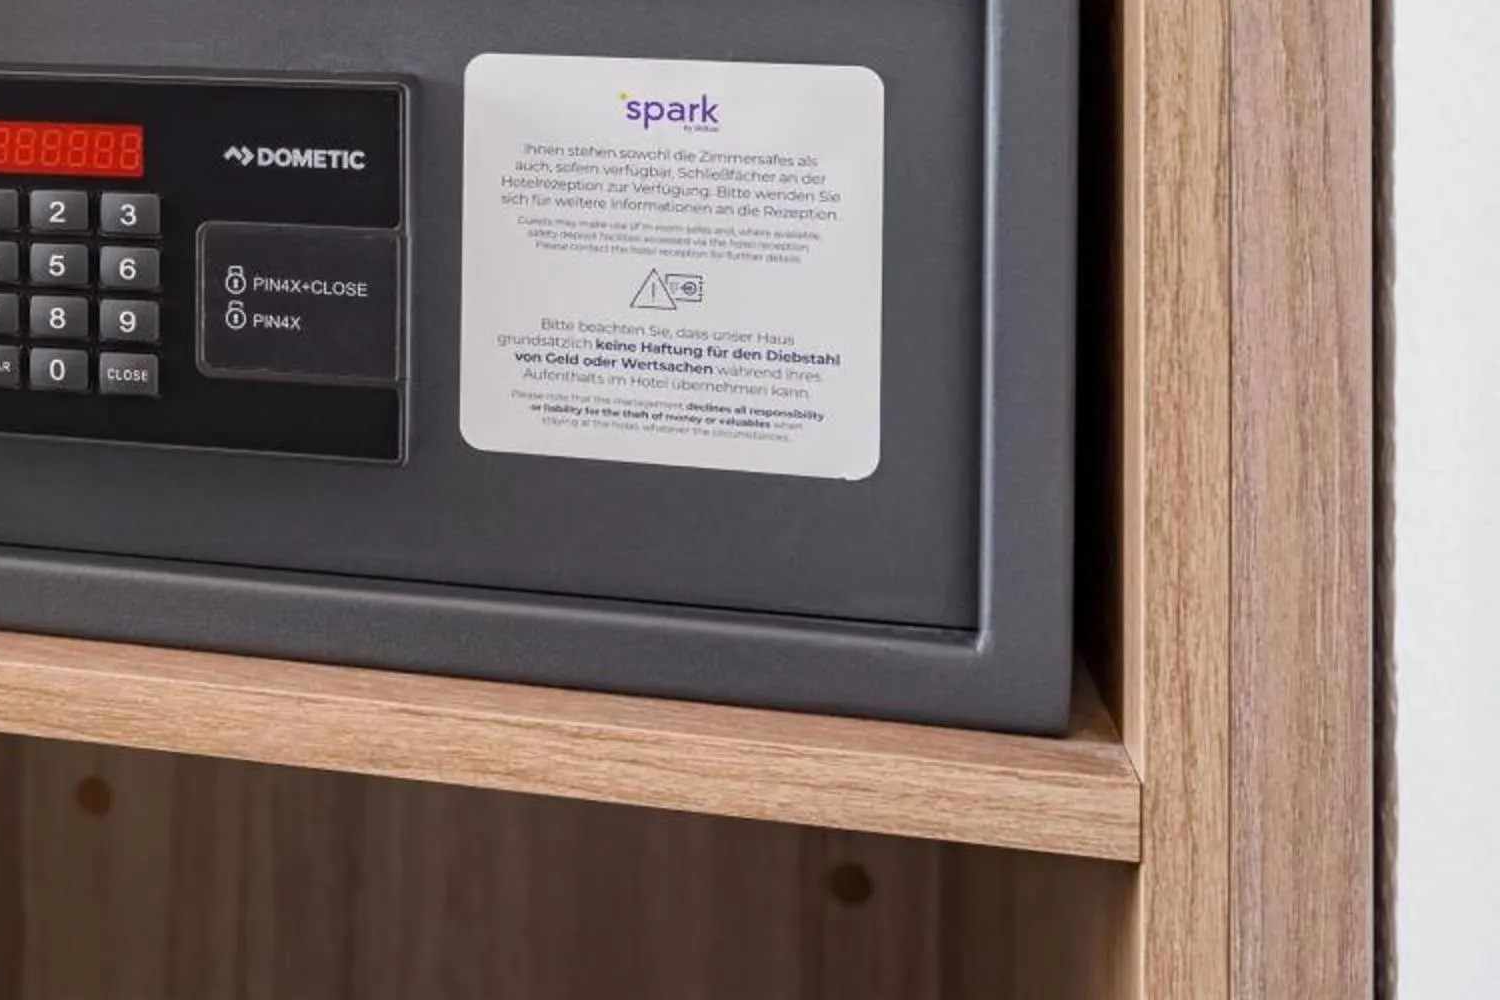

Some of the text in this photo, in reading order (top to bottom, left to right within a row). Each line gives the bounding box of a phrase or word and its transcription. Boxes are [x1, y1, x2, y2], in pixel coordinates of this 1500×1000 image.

[626, 94, 719, 129] spark
[257, 146, 366, 171] DOMETIC
[523, 143, 818, 167] Ihnen stehen sowohl die Zimmersafes als
[555, 161, 599, 174] sofern
[779, 174, 798, 183] an
[801, 173, 826, 185] der
[501, 176, 602, 193] Hotelrezeption
[606, 184, 629, 193] zur
[716, 186, 751, 199] Bitte
[755, 188, 814, 202] wenden
[818, 191, 841, 203] Sie
[49, 201, 66, 223] 2
[119, 203, 137, 226] 3
[501, 193, 529, 205] sich
[555, 196, 606, 209] weitere
[610, 198, 712, 214] Informationen
[715, 206, 734, 215] an
[738, 205, 760, 217] die
[49, 254, 65, 277] 5
[119, 258, 136, 280] 6
[252, 276, 368, 296] PIN4X+CLOSE
[49, 307, 66, 329] 8
[119, 311, 136, 333] 9
[252, 313, 301, 331] PIN4X
[541, 318, 795, 346] Bitte beachten Sie, dass unser Haus
[515, 352, 541, 363] von
[545, 351, 579, 365] Geld
[583, 354, 617, 368] oder
[621, 357, 713, 375] Wertsachen
[595, 338, 637, 352] keine
[641, 341, 703, 359] Haftung
[707, 345, 729, 358] für
[732, 347, 762, 360] den
[766, 349, 841, 366] Diebstahl
[49, 359, 65, 381] 0
[108, 367, 148, 382] CLOSE
[522, 367, 604, 384] Aufenthalts
[607, 373, 626, 385] im
[630, 375, 668, 389] Hotel
